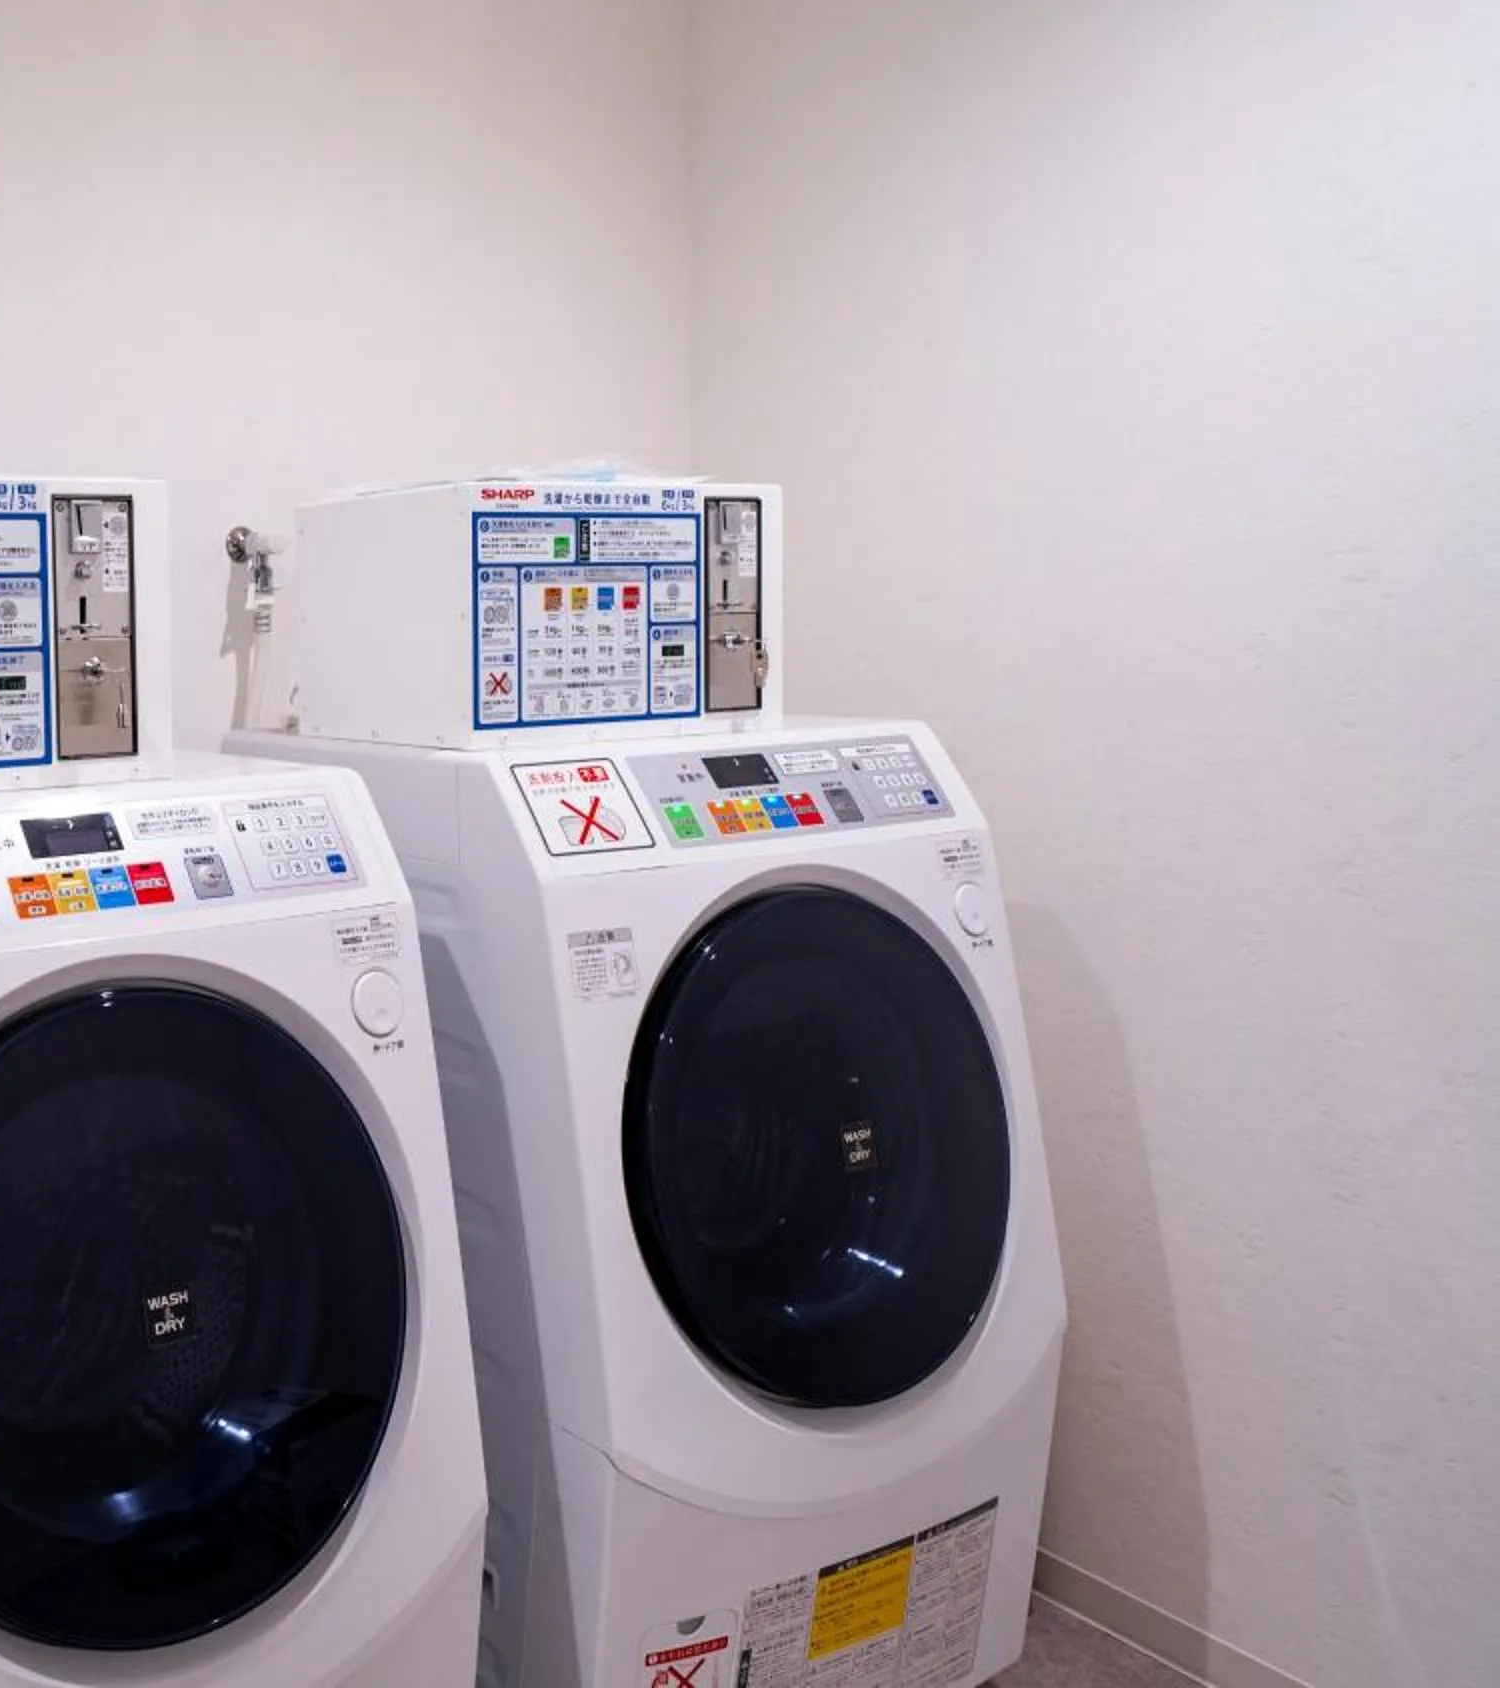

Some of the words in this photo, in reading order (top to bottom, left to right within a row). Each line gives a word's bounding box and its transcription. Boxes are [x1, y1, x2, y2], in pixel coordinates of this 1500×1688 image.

[480, 489, 535, 501] SHARP
[147, 1290, 189, 1311] WASH
[155, 1316, 185, 1335] DRY
